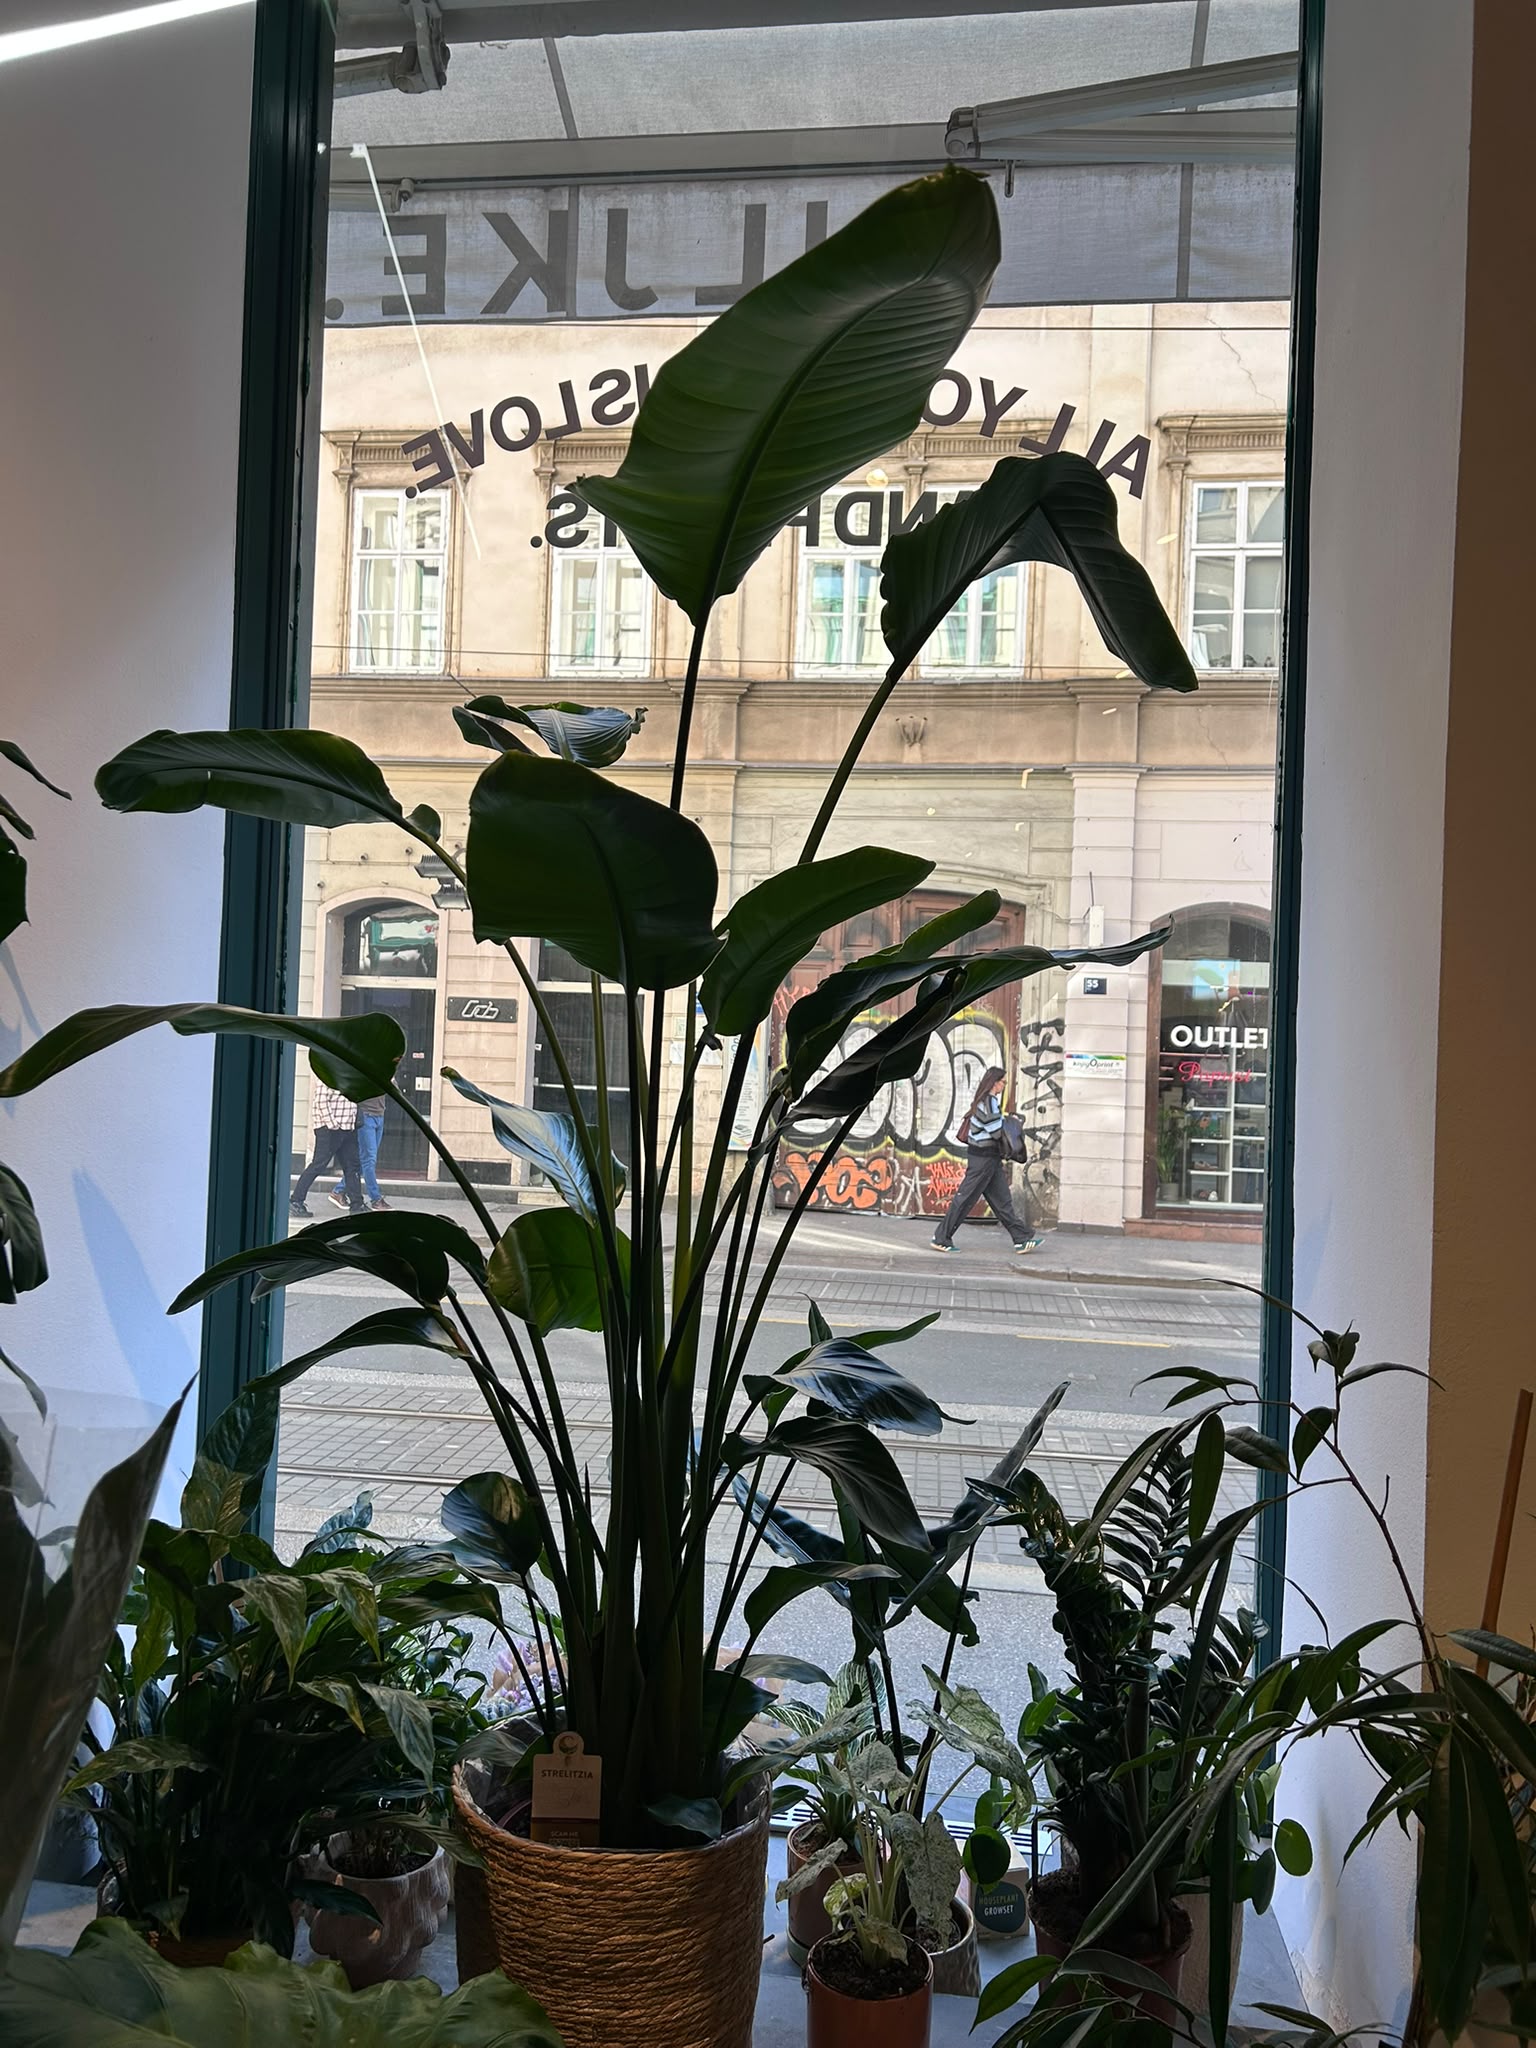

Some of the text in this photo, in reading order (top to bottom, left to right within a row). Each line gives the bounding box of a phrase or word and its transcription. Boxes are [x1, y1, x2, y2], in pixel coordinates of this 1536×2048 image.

[1087, 979, 1098, 988] 55
[1170, 1024, 1269, 1050] OUTLET
[541, 1770, 593, 1779] STRELITZIA
[979, 1894, 1018, 1905] HOUSEPLANT
[984, 1905, 1014, 1916] GROWSET
